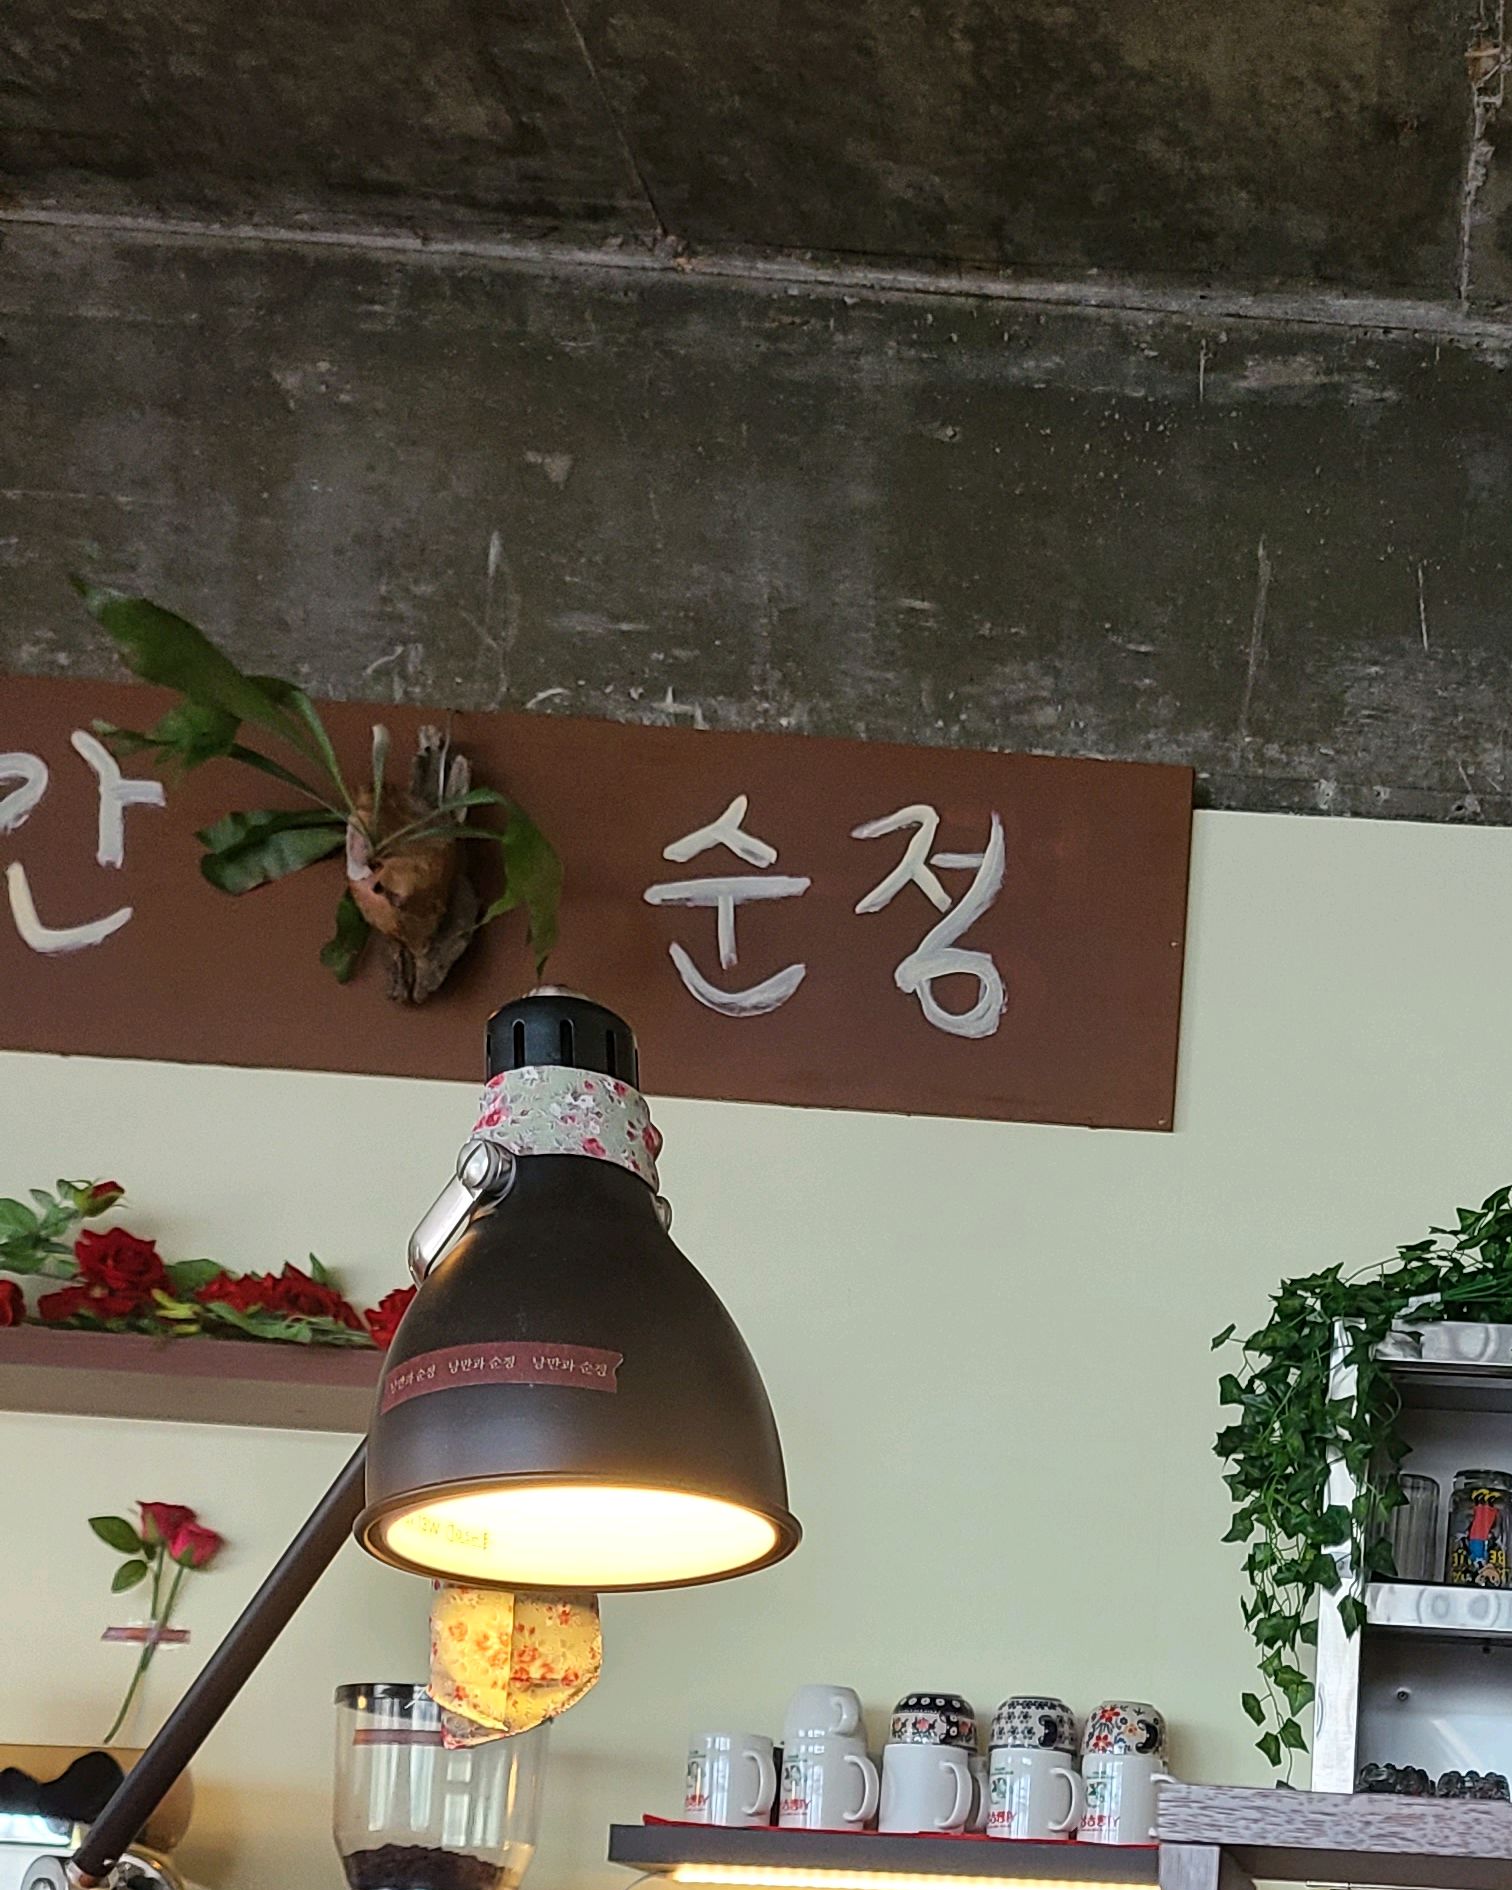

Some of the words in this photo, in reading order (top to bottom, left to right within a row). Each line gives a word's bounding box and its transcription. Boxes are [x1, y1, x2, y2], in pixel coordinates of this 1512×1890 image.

[644, 793, 1006, 1040] 순정
[448, 1356, 486, 1375] 낭만과
[532, 1355, 576, 1373] 낭만과
